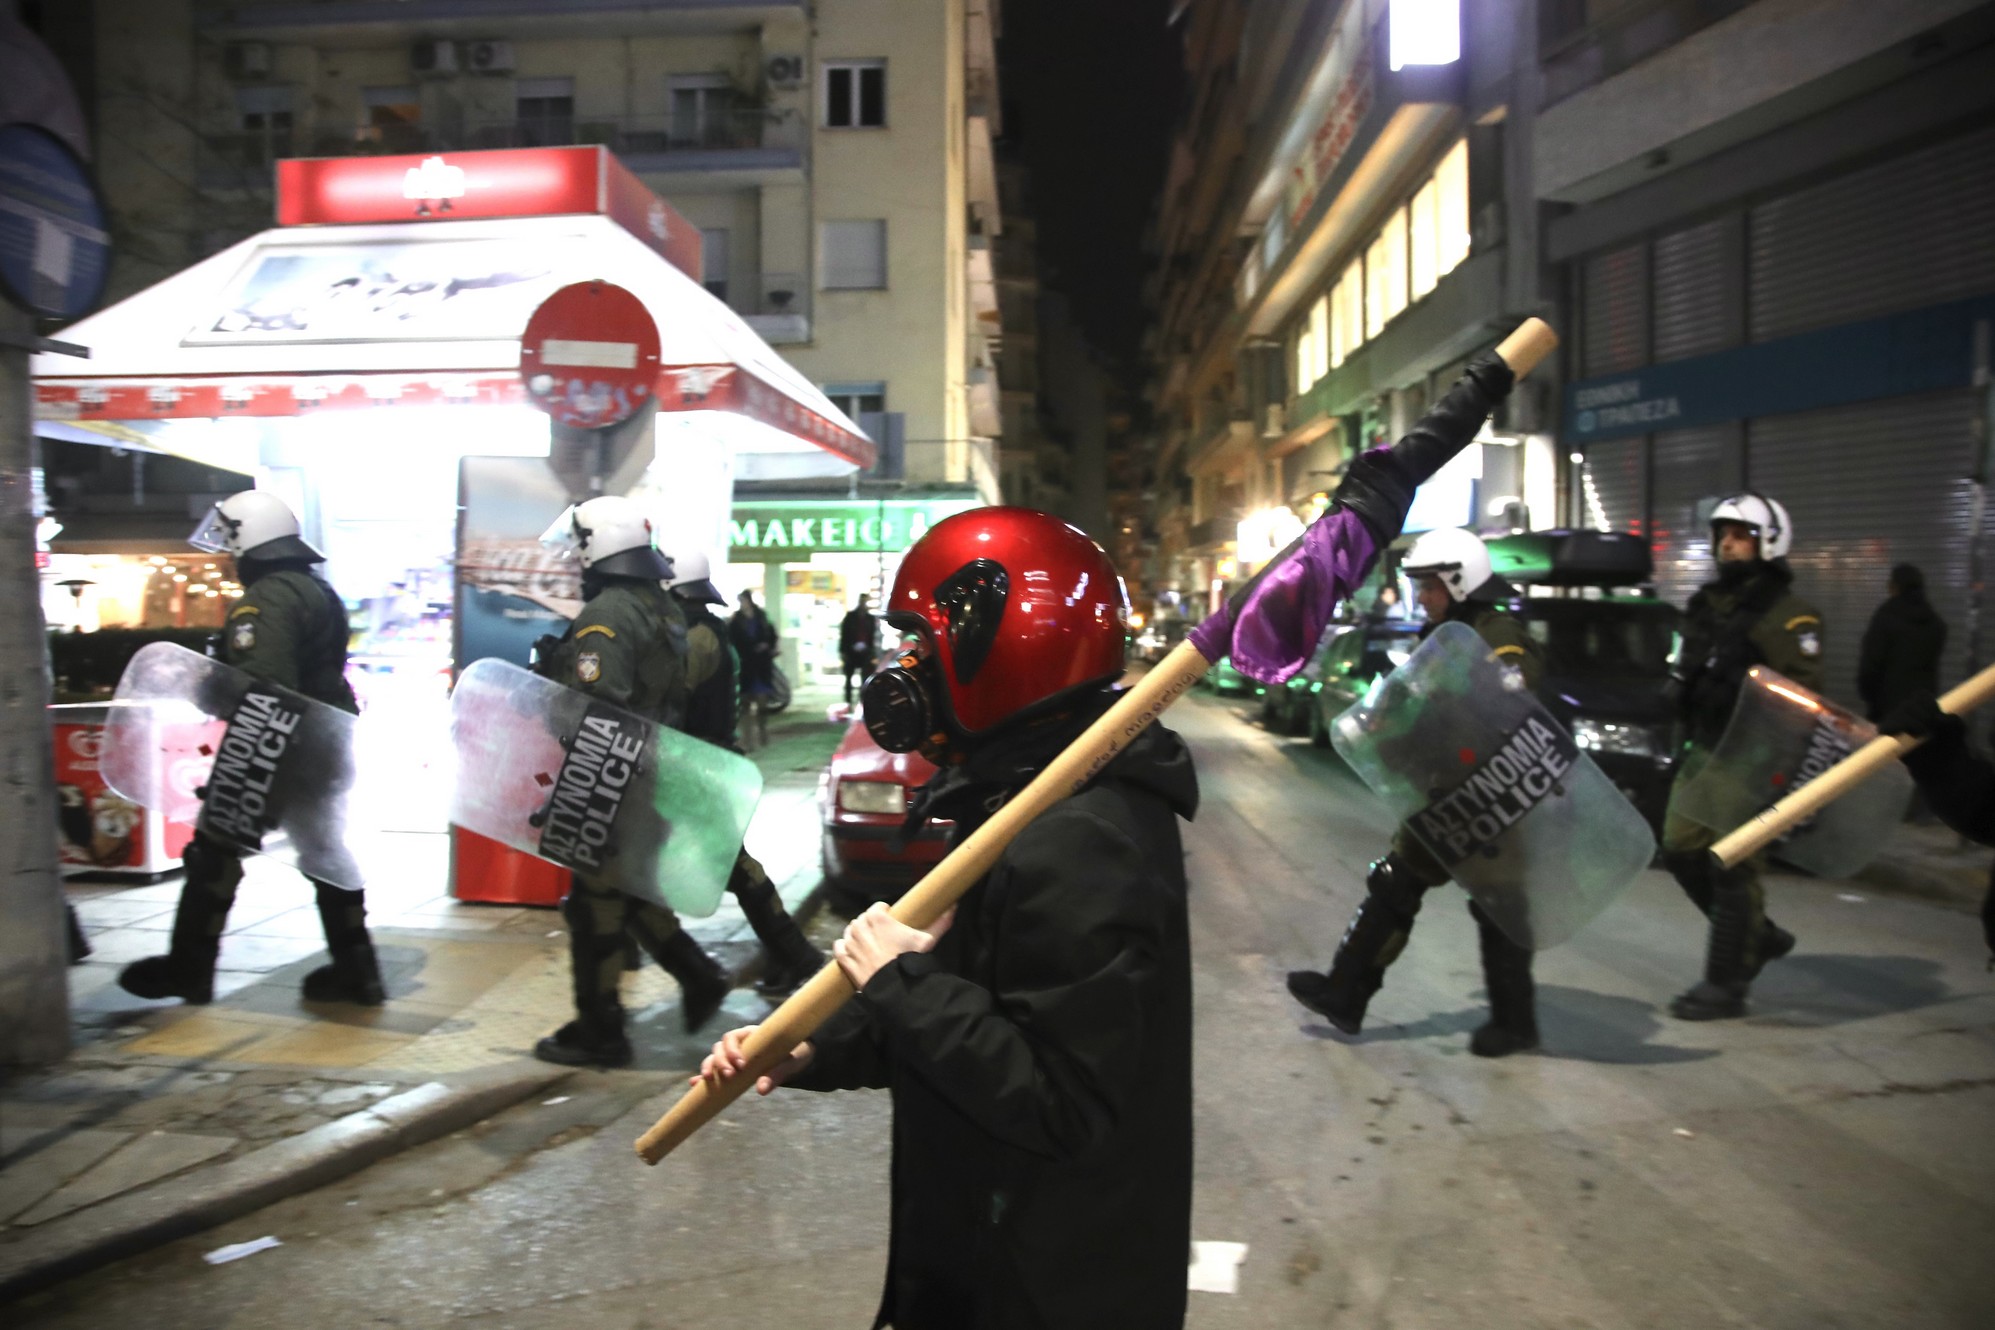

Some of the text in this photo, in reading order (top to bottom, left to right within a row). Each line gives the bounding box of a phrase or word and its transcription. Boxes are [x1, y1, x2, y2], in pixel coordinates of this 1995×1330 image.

[209, 692, 280, 835] ΑΣΤΥΝΟΜΙΑ
[237, 706, 301, 839] POLICE
[542, 715, 620, 862] ΑΣΤΥΝΟΜΙΑ
[574, 732, 644, 867] POLICE
[1419, 717, 1556, 841] ΑΣΤΥΝΟΜΙΑ
[1447, 745, 1571, 857] POLICE
